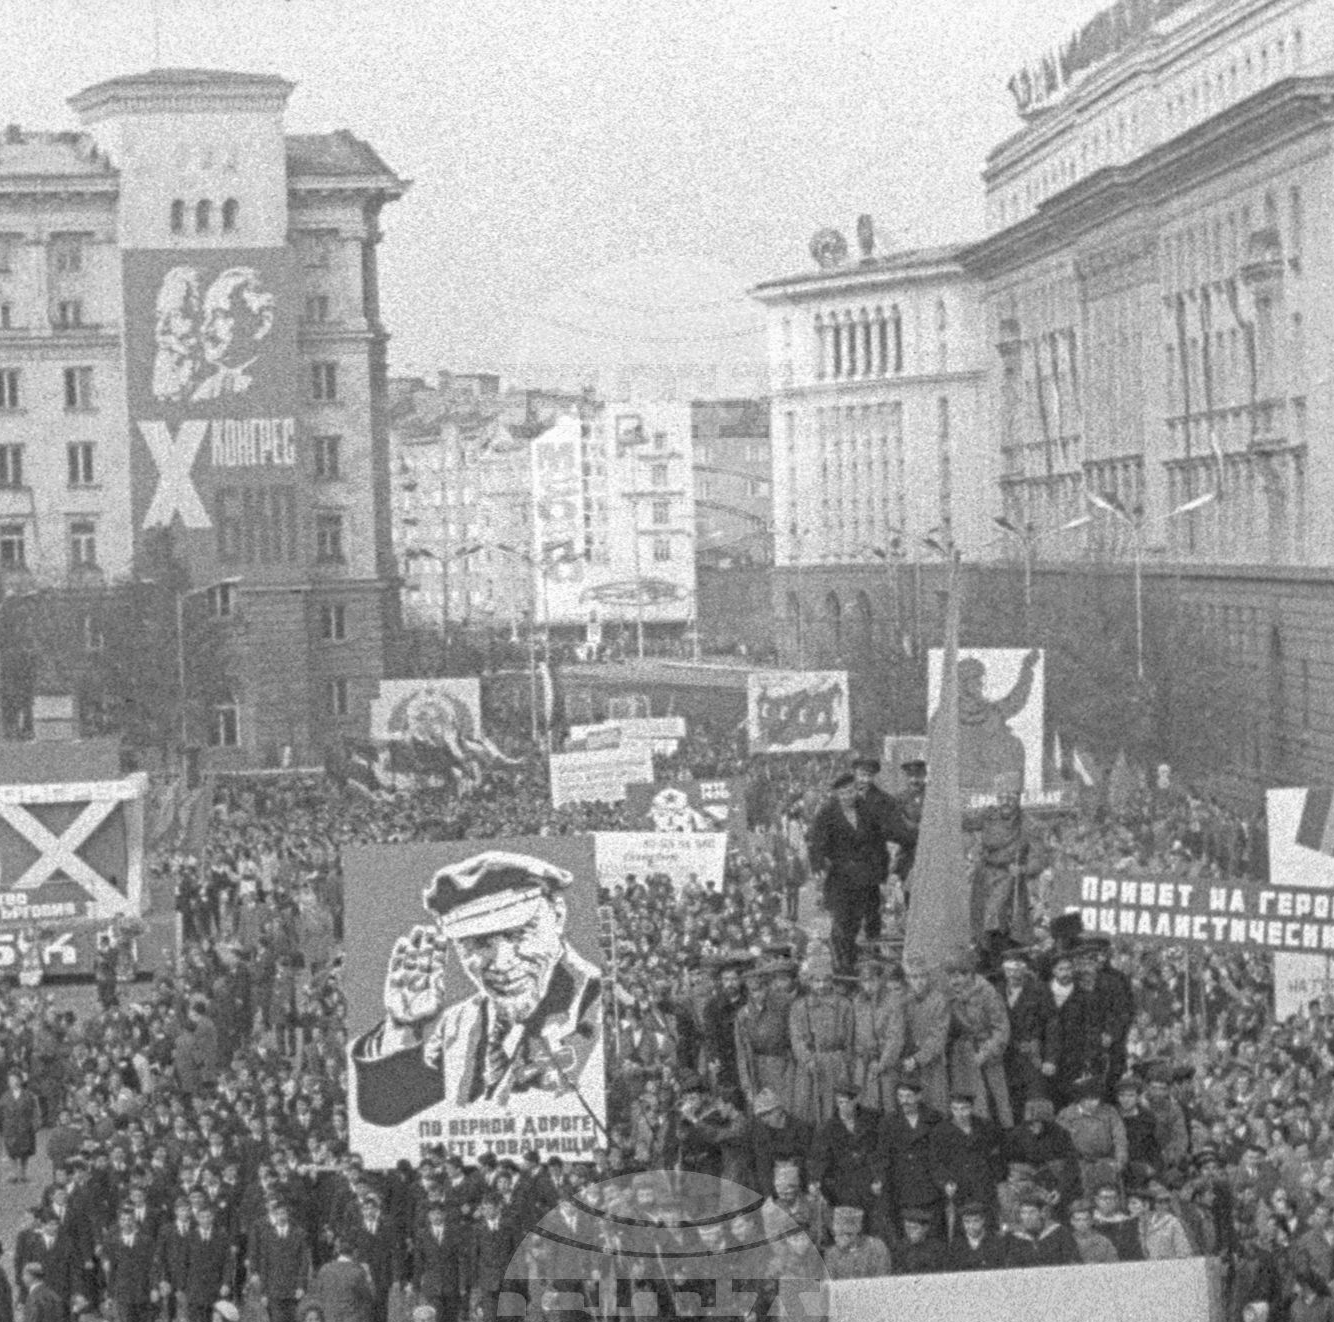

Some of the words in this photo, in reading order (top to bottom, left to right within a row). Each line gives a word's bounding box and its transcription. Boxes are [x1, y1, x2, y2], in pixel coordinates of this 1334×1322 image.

[1080, 873, 1195, 909] ПРИВЕТ
[1208, 885, 1247, 915] НА
[418, 1119, 443, 1138] ПО
[448, 1111, 516, 1135] ВЕРНОЙ
[522, 1115, 594, 1135] ДОРОГЕ
[419, 1140, 476, 1158] ИЕТЕ
[484, 1136, 597, 1158] ТОВАРИЩИ
